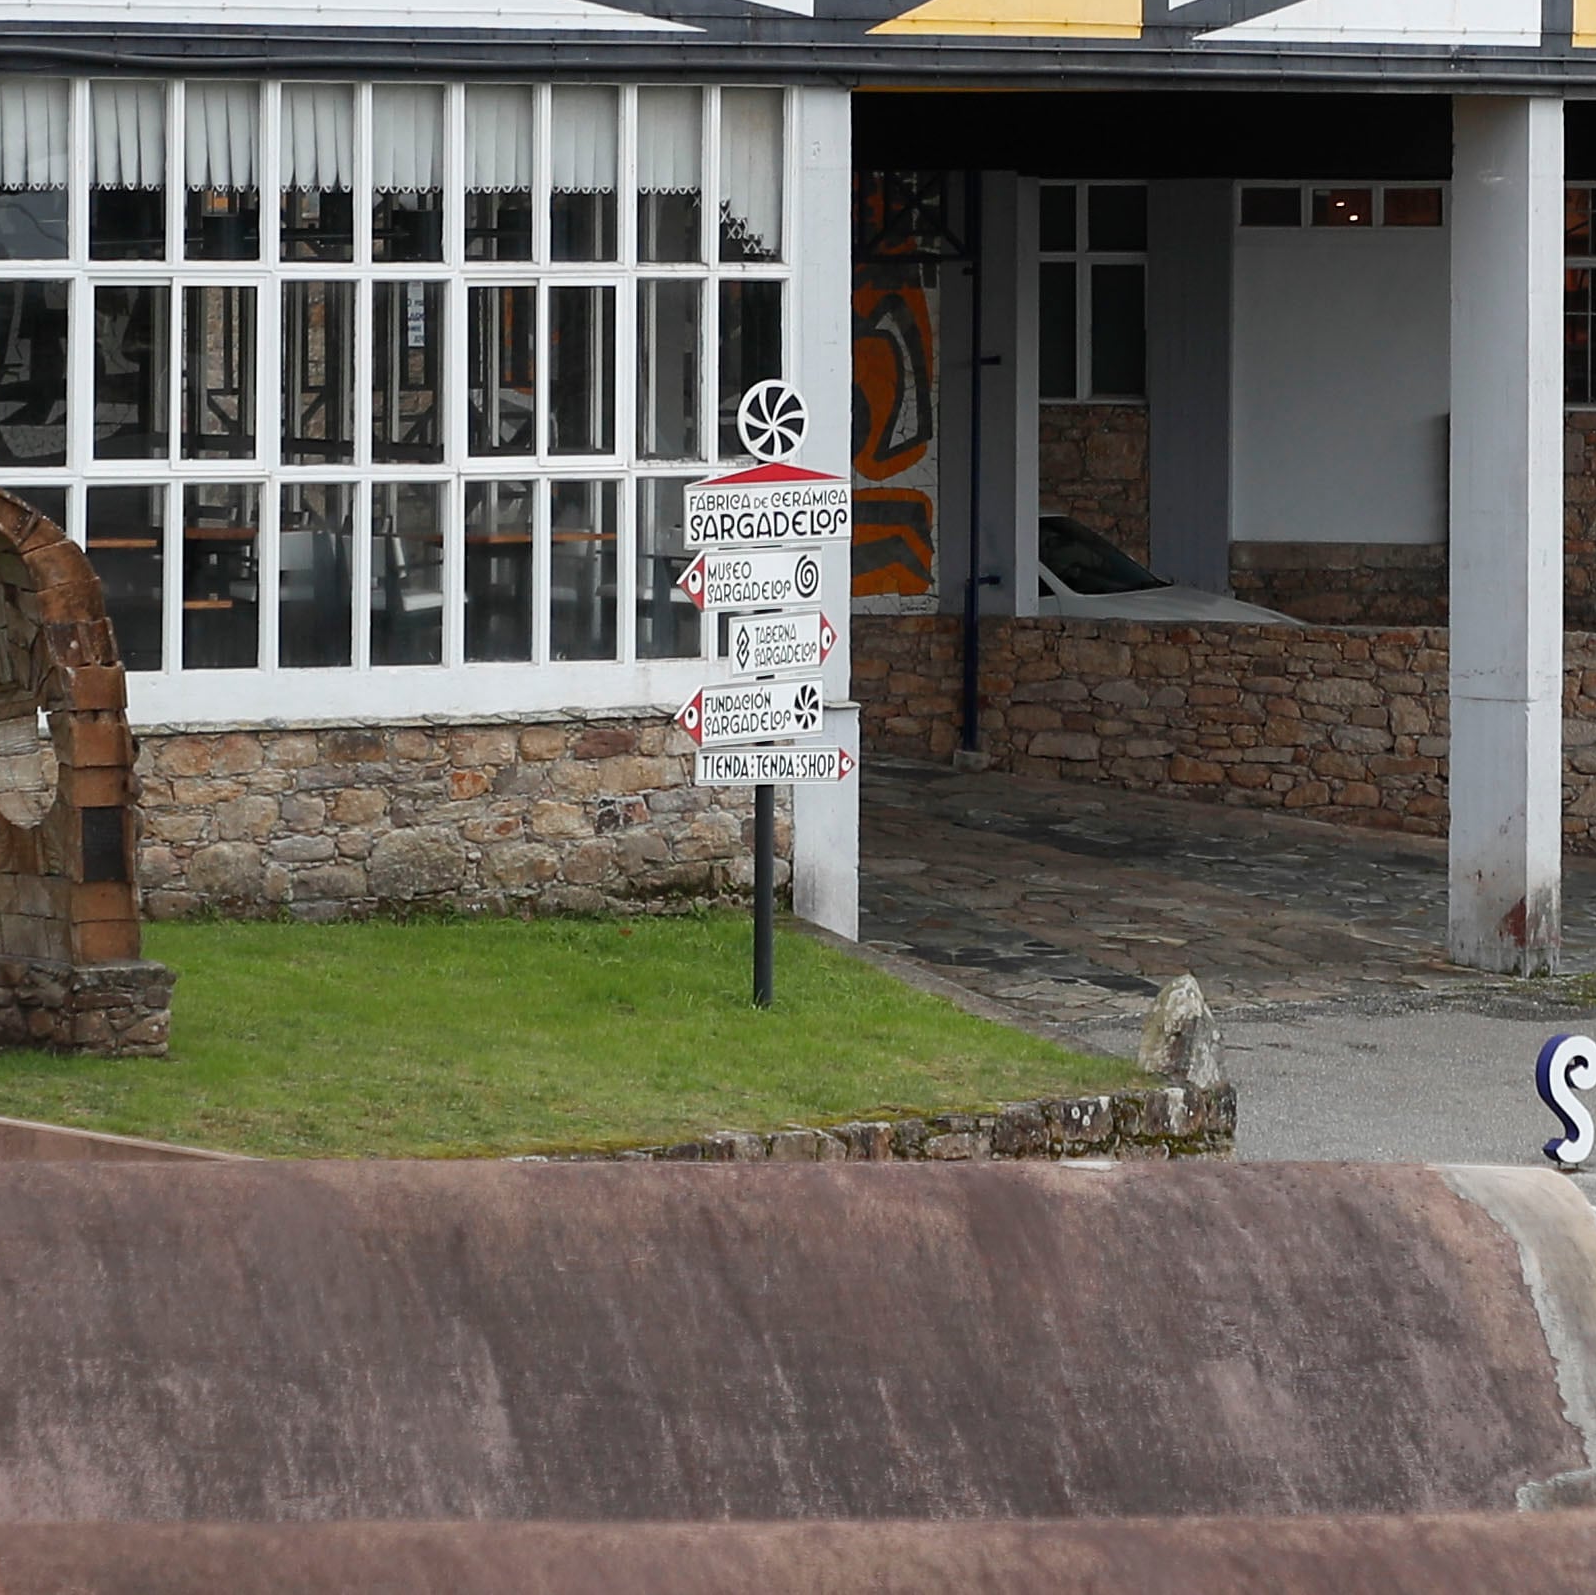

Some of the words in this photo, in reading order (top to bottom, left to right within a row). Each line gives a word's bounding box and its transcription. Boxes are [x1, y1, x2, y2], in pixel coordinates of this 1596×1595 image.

[689, 492, 751, 512] FÁBRICA
[770, 487, 848, 507] CERÁMICA
[689, 508, 848, 542] SARGADELOS
[707, 561, 752, 580] MUSEO
[707, 579, 791, 604] SARGADELOS
[754, 623, 796, 645] TABERNA
[754, 641, 817, 668] SARGADELOS
[704, 687, 771, 715] FUNDACIÓN
[704, 710, 791, 737] SARGADELOS
[801, 754, 836, 777] SHOP
